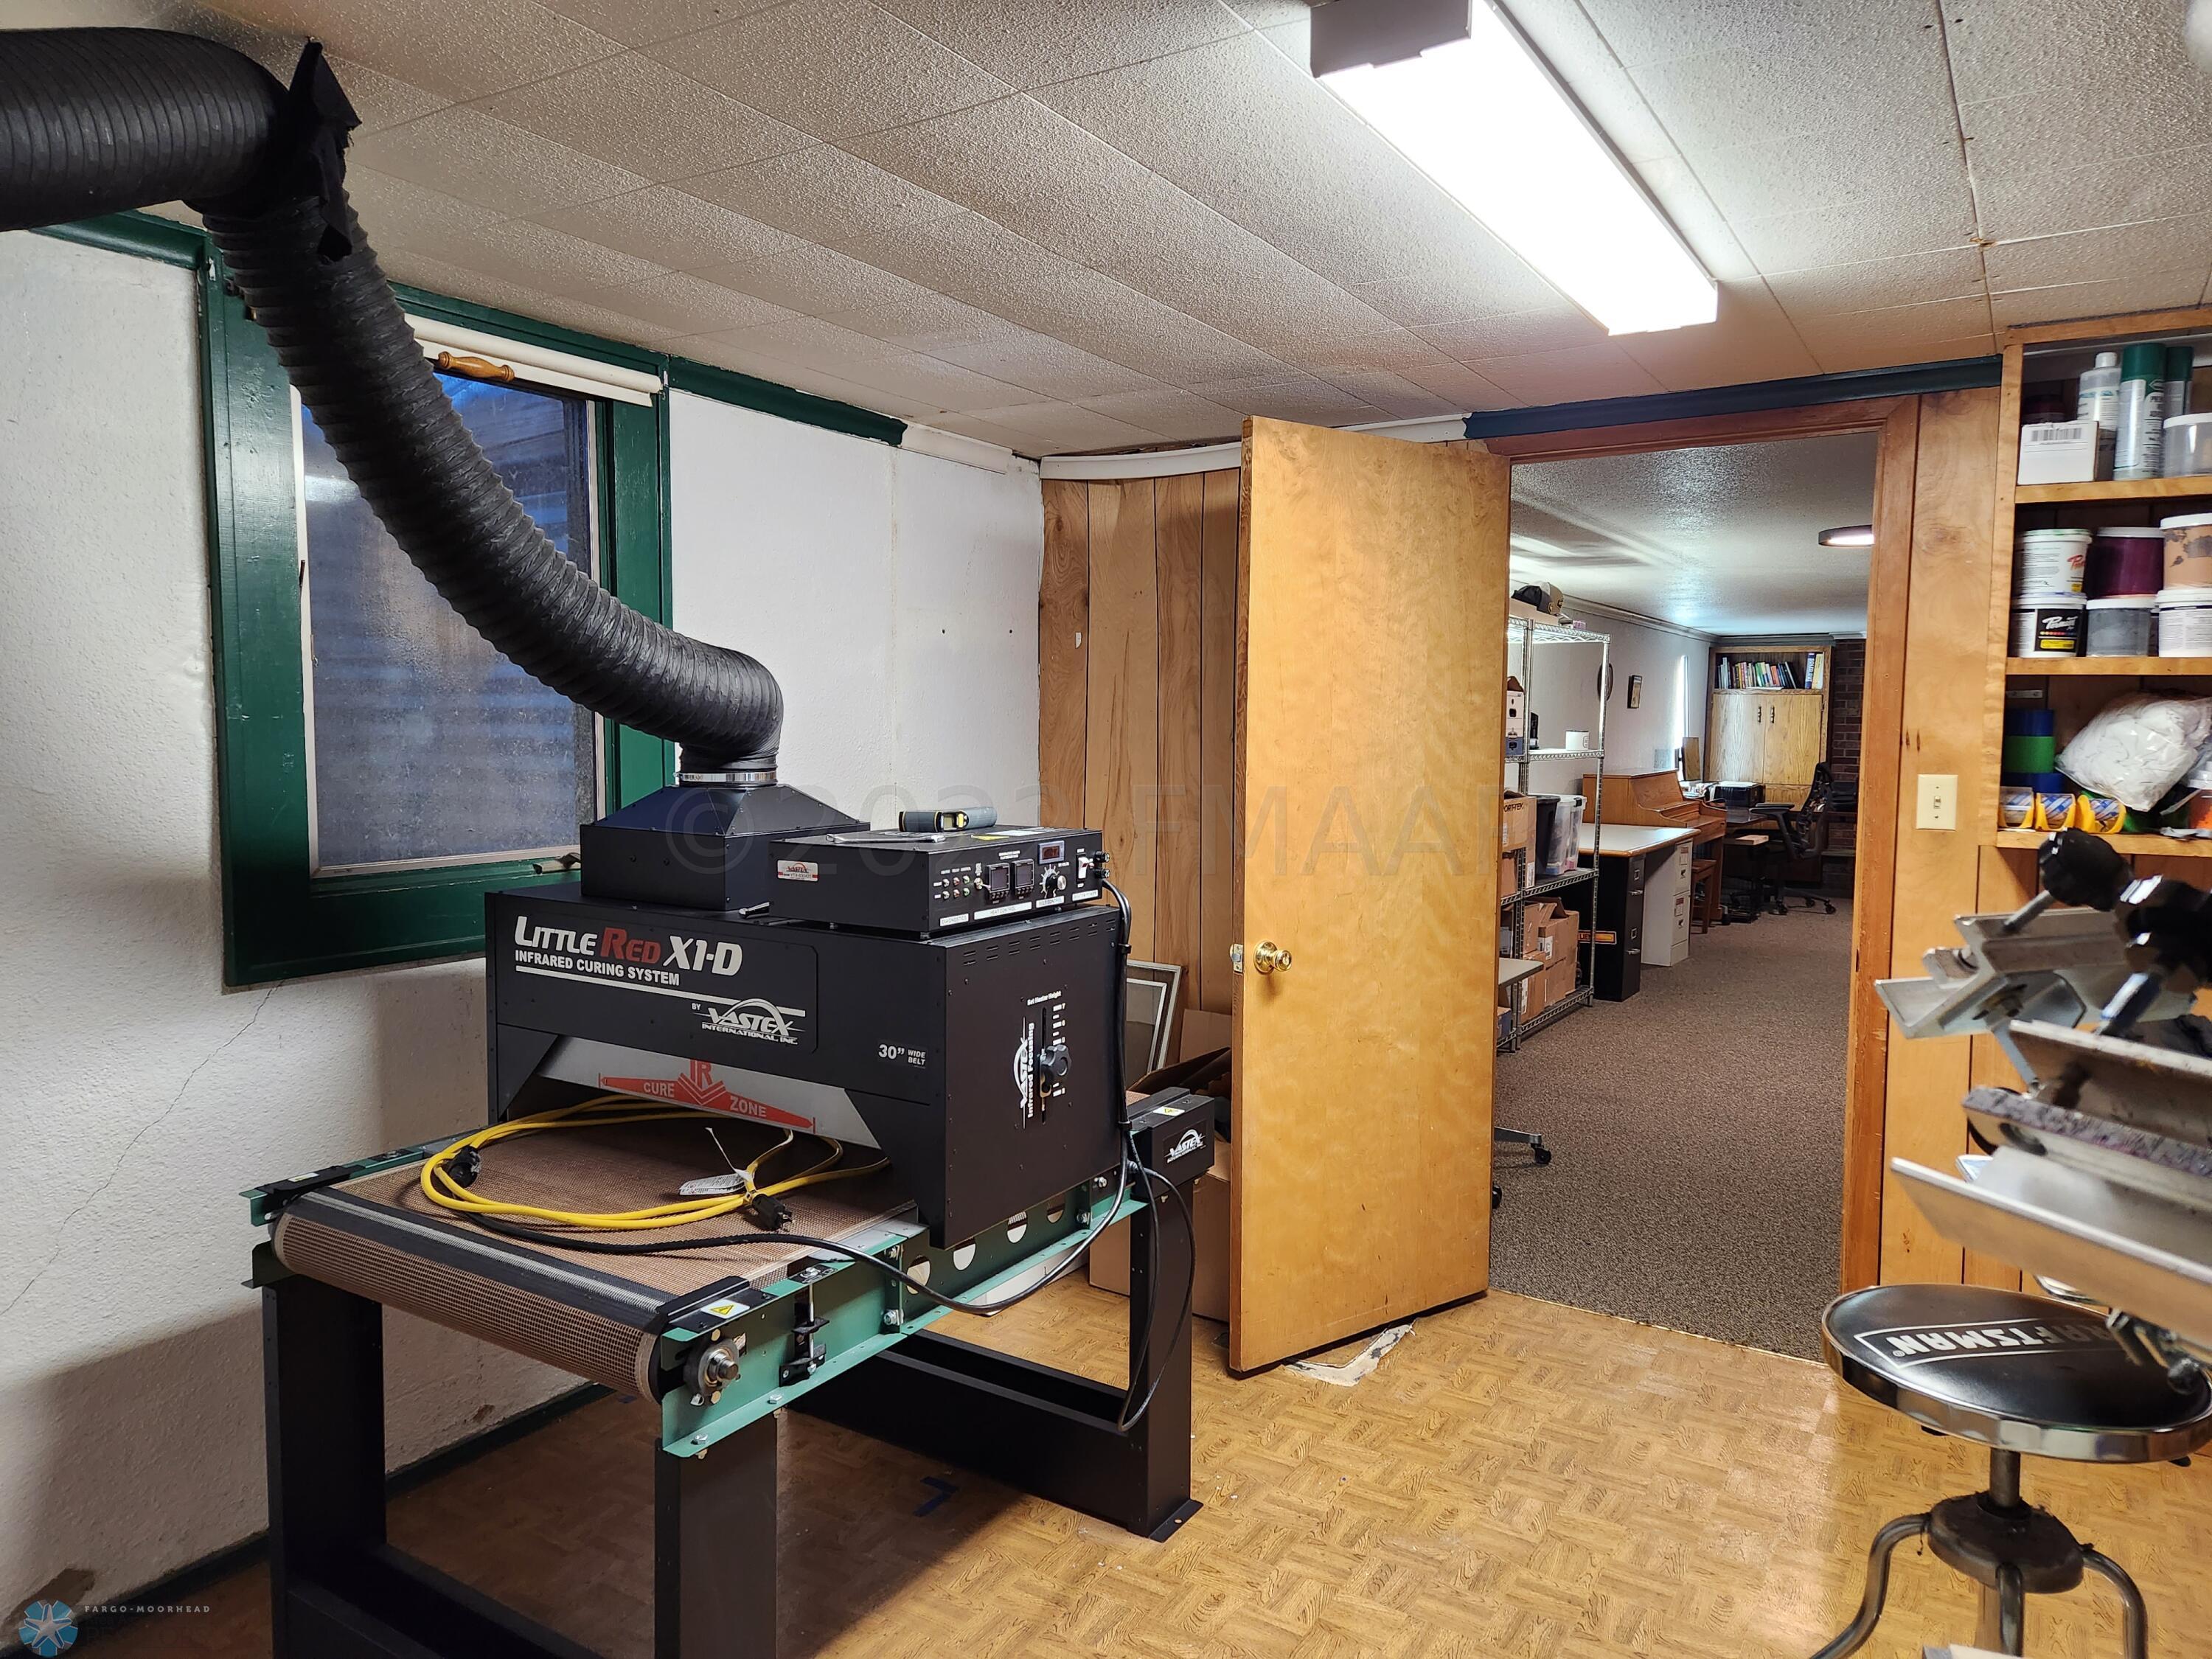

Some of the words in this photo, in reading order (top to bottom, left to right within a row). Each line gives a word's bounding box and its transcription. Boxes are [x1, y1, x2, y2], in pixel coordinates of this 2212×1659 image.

[515, 916, 598, 956] LITTLE
[600, 927, 661, 964] RED
[664, 935, 742, 976] X1-D
[515, 950, 573, 970] INFRARED
[577, 960, 624, 978] CURING
[627, 966, 680, 987] SYSTEM
[692, 1003, 701, 1011] BY
[708, 999, 794, 1036] VASTEX
[908, 1049, 926, 1059] WIDE
[908, 1057, 926, 1065] BELT
[643, 1082, 675, 1098] CURE
[730, 1095, 768, 1118] ZONE
[1169, 1130, 1203, 1158] VASTEX
